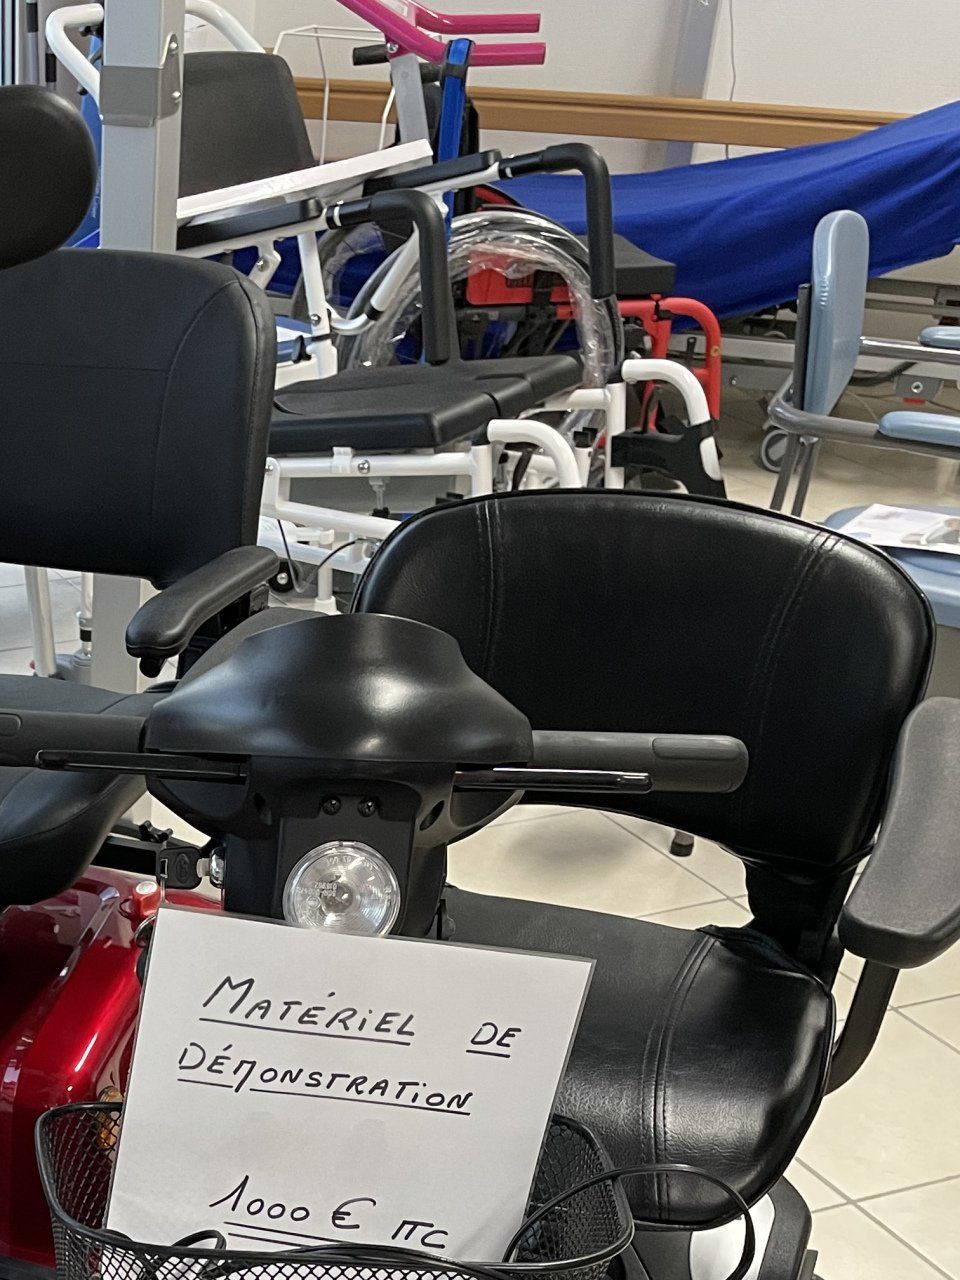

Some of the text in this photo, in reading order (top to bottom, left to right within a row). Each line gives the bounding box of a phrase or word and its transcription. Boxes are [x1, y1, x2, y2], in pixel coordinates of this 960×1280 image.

[469, 1021, 522, 1048] DE
[209, 1175, 310, 1222] 1000
[331, 1198, 377, 1230] €
